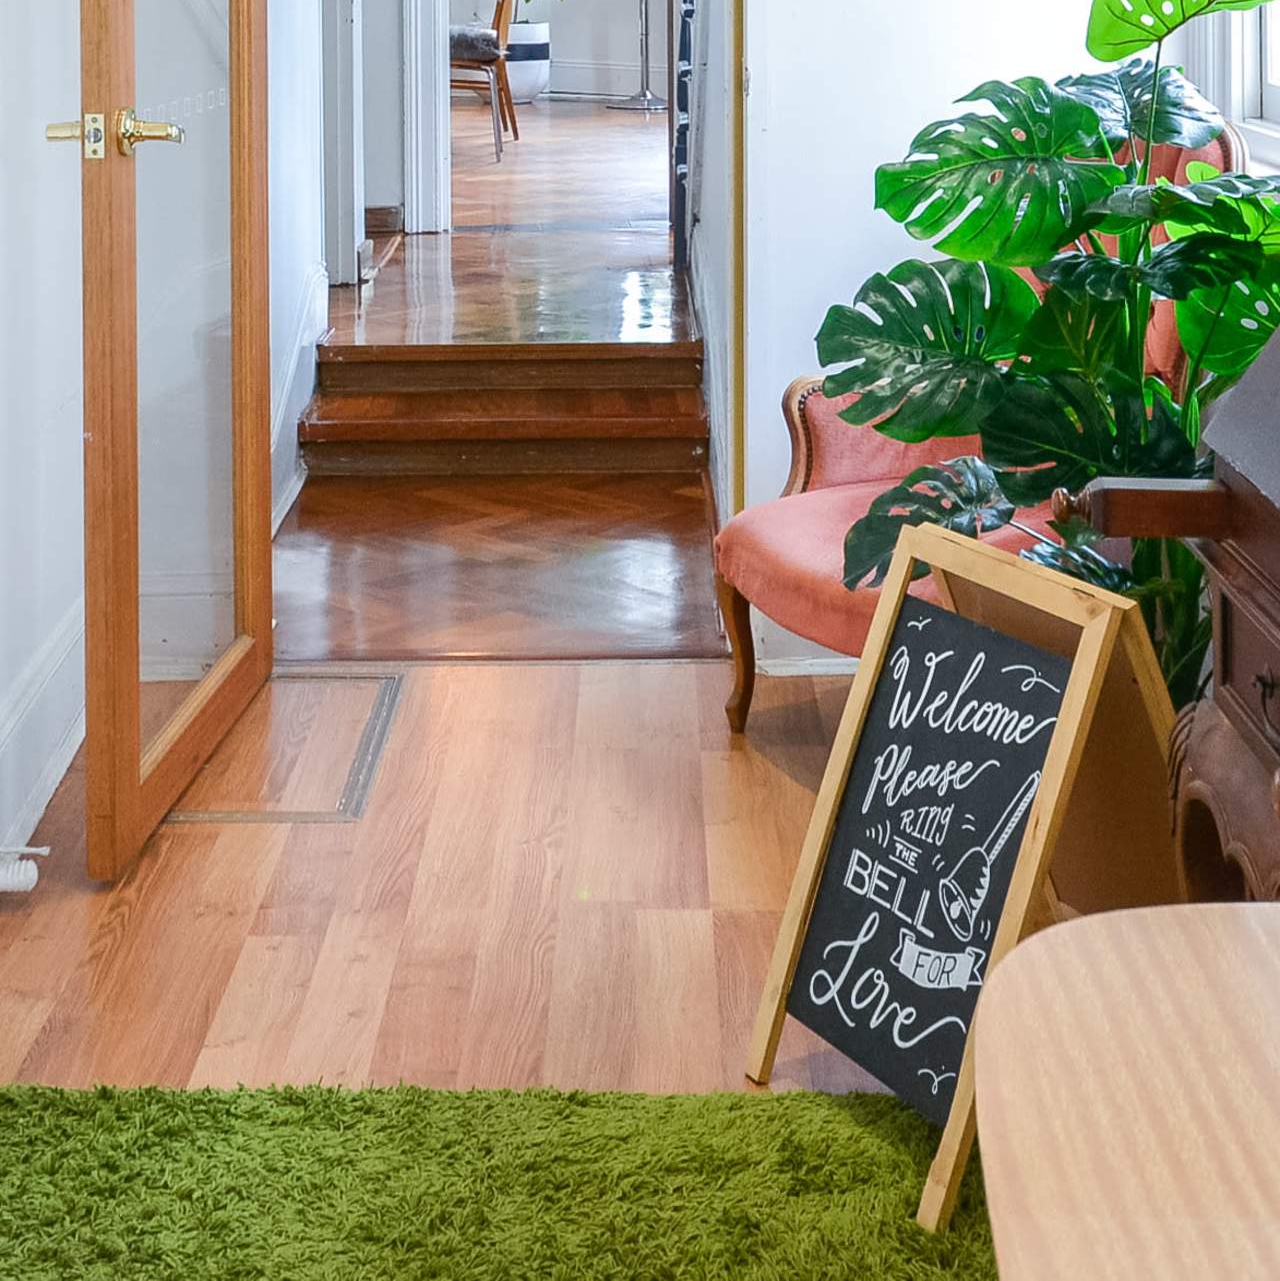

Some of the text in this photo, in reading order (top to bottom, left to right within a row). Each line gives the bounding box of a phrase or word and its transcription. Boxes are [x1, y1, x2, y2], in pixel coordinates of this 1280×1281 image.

[890, 646, 1058, 744] Welcome
[862, 744, 1000, 814] Please
[844, 848, 935, 939] BELL
[894, 843, 918, 867] THE
[809, 912, 967, 1048] Love
[912, 951, 957, 986] FOR
